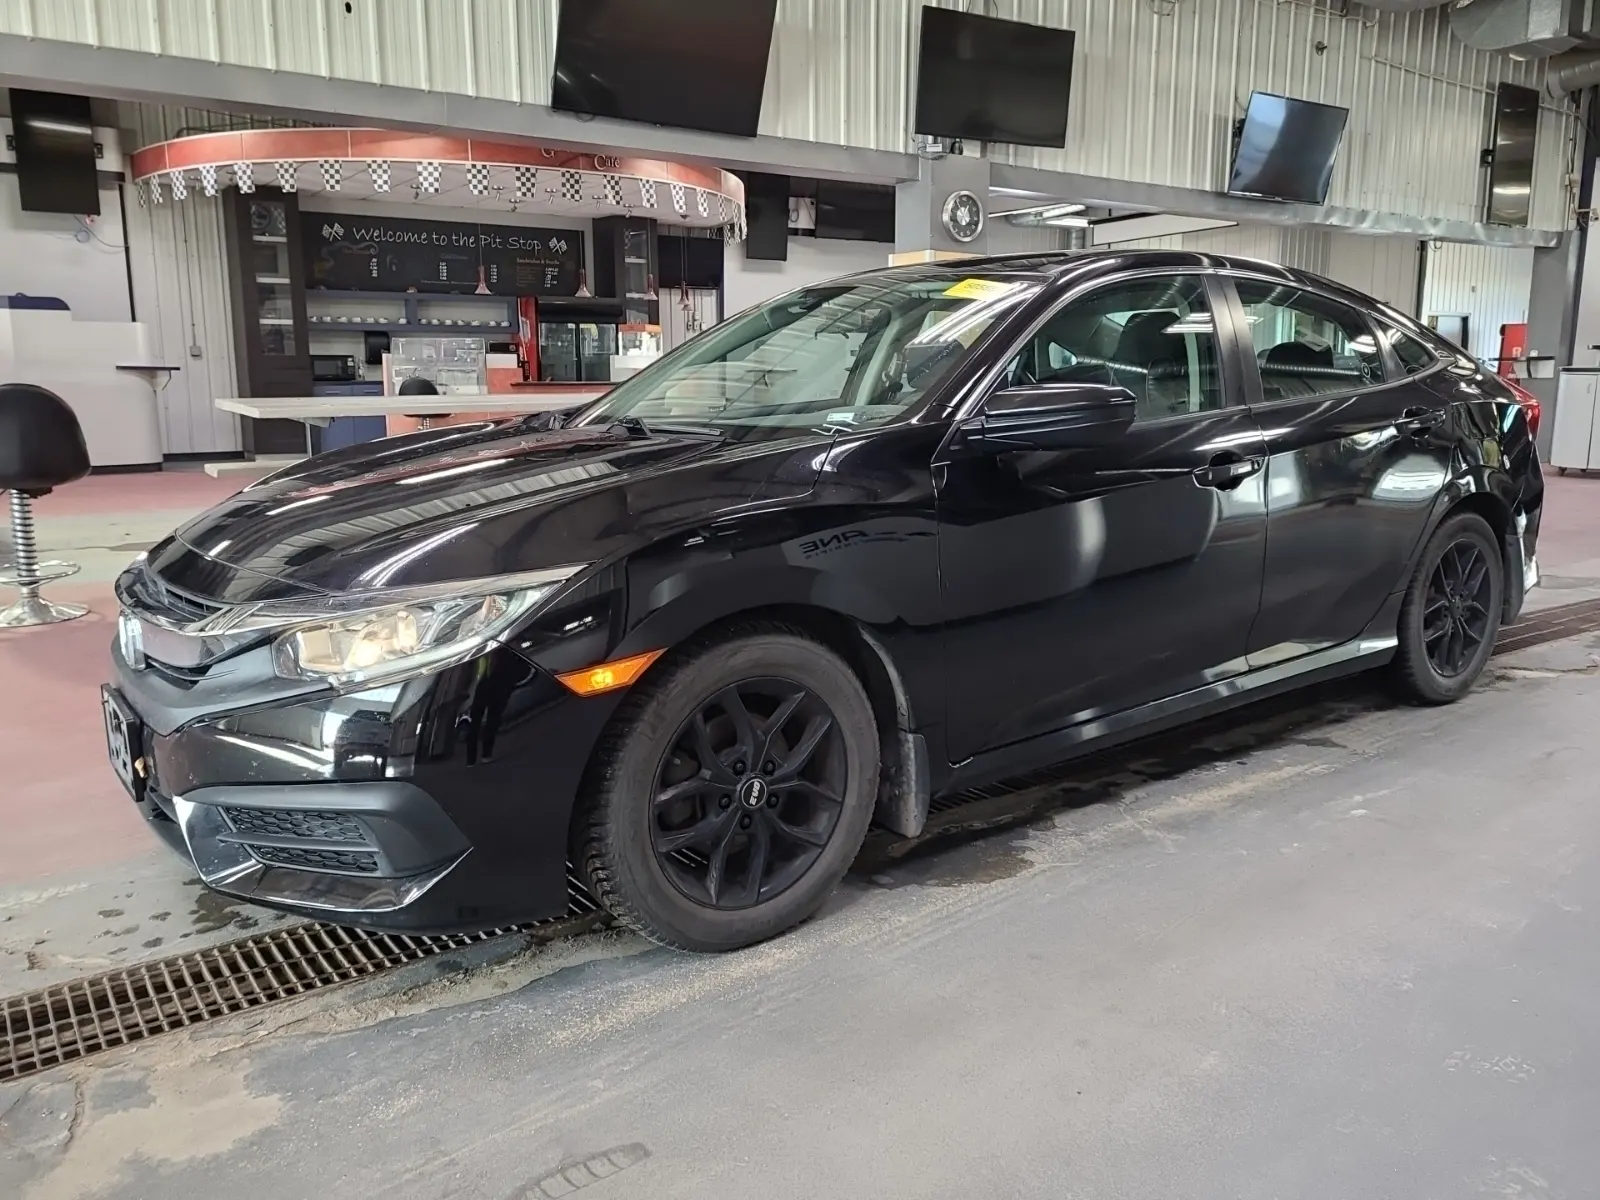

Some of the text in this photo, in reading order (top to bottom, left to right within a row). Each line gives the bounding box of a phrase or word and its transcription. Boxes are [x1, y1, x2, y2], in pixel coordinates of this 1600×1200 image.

[352, 226, 542, 256] Welcome to the Pit Stop
